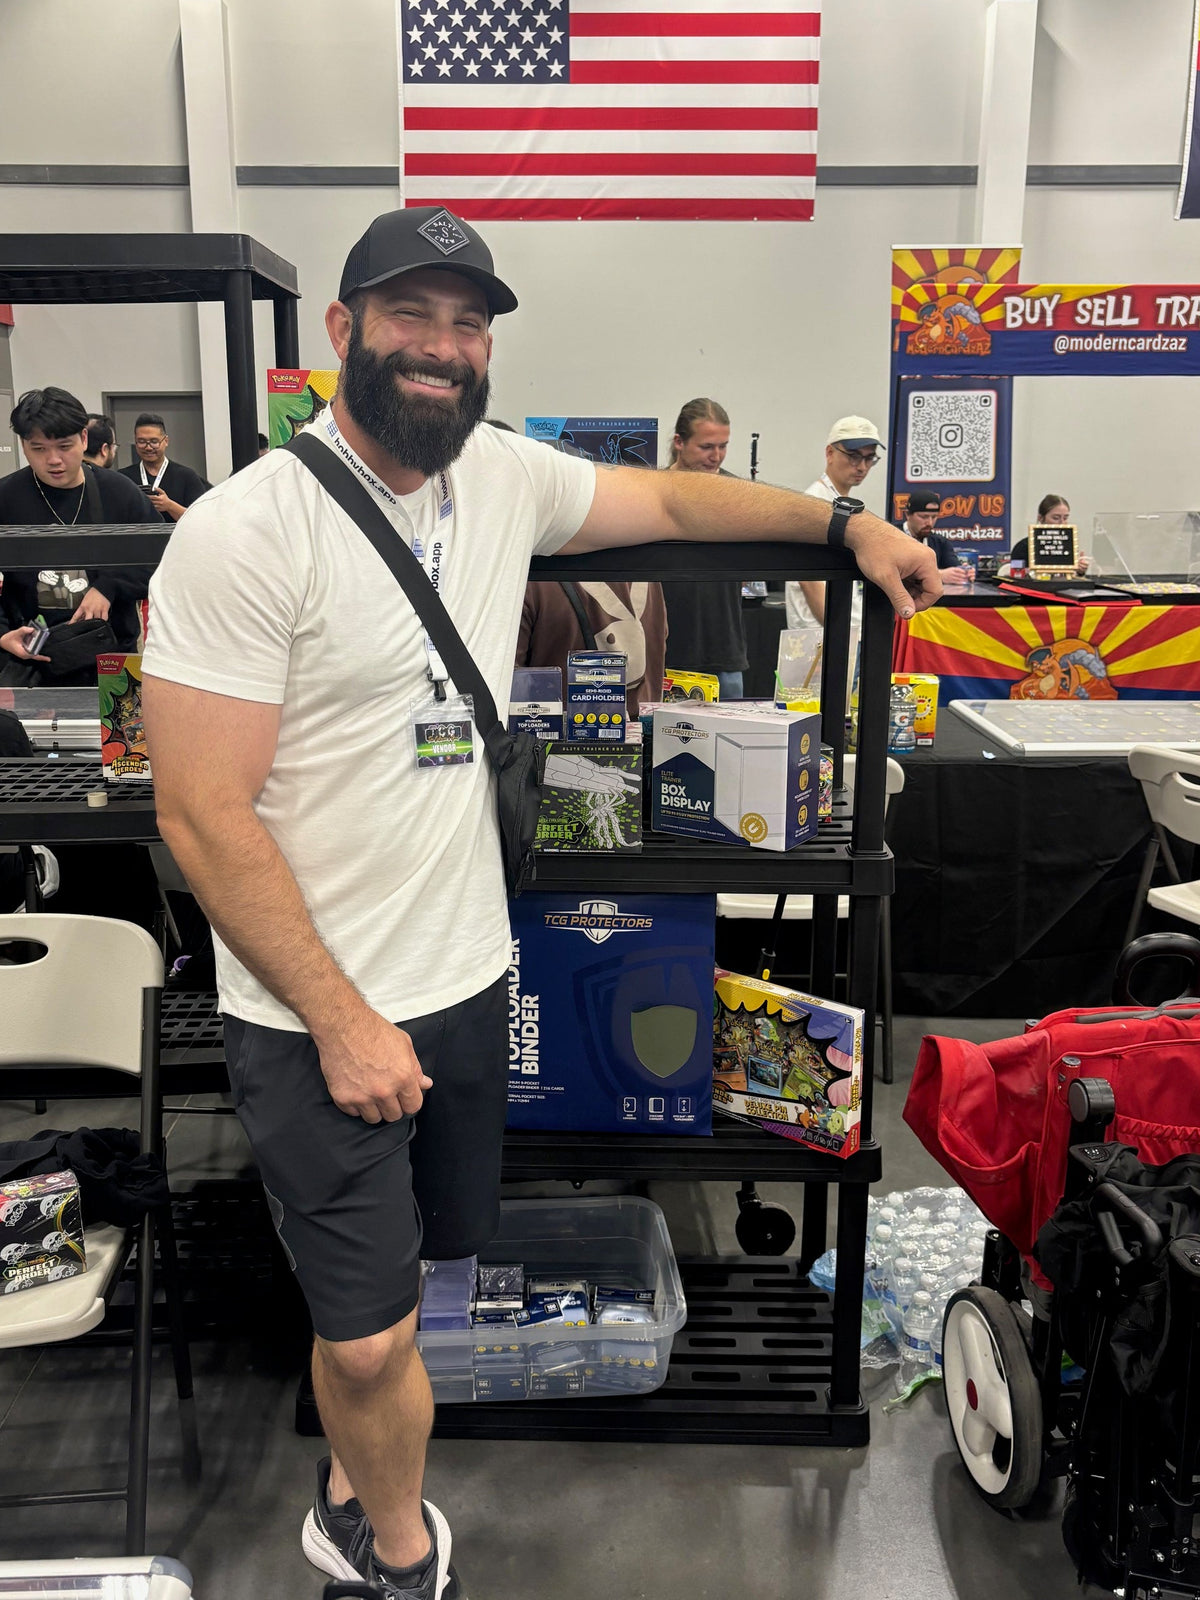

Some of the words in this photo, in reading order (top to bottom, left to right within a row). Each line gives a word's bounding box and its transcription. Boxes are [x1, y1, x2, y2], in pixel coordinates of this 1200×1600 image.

[433, 221, 457, 231] SALTY
[434, 235, 456, 244] CREW
[1004, 294, 1062, 329] BUY
[1074, 294, 1140, 327] SELL
[1055, 333, 1187, 354] @moderncardzaz
[893, 493, 977, 520] FOW
[978, 494, 1006, 517] US
[672, 728, 709, 739] PROTECTORS
[432, 744, 457, 754] VENDOR
[111, 760, 149, 771] ASCENDED
[115, 767, 143, 776] HEROES
[661, 776, 682, 784] TRAINER
[661, 782, 687, 798] BOX
[661, 794, 712, 812] DISPLAY
[536, 823, 579, 833] ERFECT
[544, 914, 568, 926] TCG
[570, 915, 653, 929] PROTECTORS
[521, 994, 540, 1075] BINDER
[744, 1099, 772, 1111] DELUXE
[774, 1104, 788, 1114] PIN
[746, 1107, 789, 1121] COLLECTION
[8, 1258, 56, 1278] PERFECT
[14, 1268, 52, 1283] ORDER
